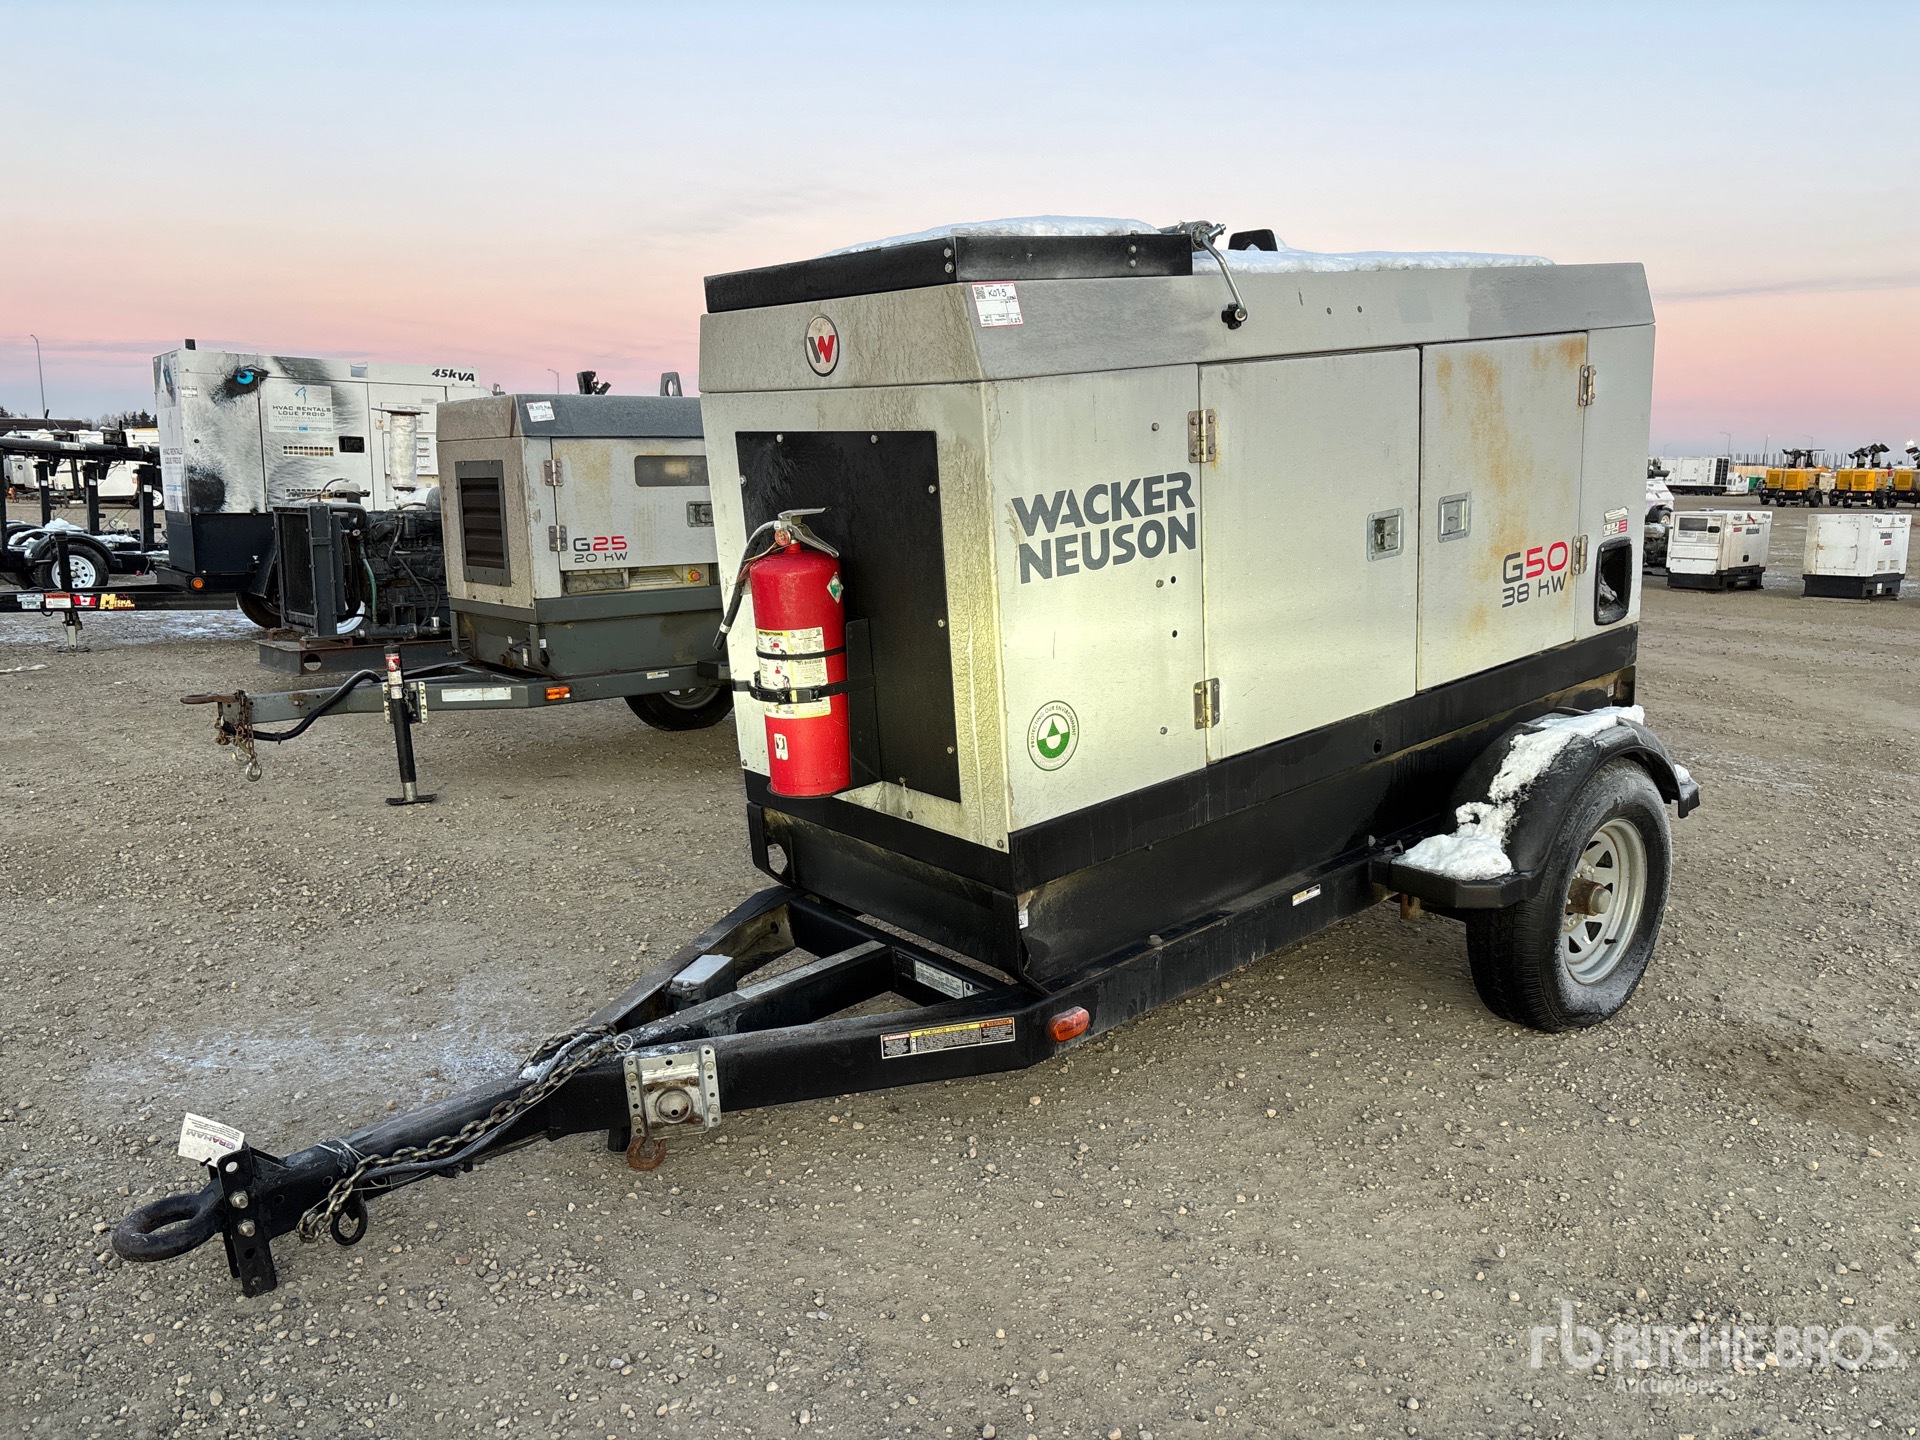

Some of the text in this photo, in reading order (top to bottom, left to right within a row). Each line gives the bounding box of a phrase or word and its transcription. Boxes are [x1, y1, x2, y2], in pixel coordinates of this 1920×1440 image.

[808, 335, 836, 364] W
[431, 368, 475, 382] 45kVA
[1011, 471, 1195, 537] WACKER
[572, 535, 628, 552] G25
[1018, 511, 1196, 584] NEUSON
[574, 553, 598, 564] 20
[1502, 541, 1569, 584] G50
[1501, 582, 1530, 608] 38
[1031, 705, 1077, 748] PROTECTING OUR ENVIRONMENT
[185, 1128, 236, 1151] GRAHAM
